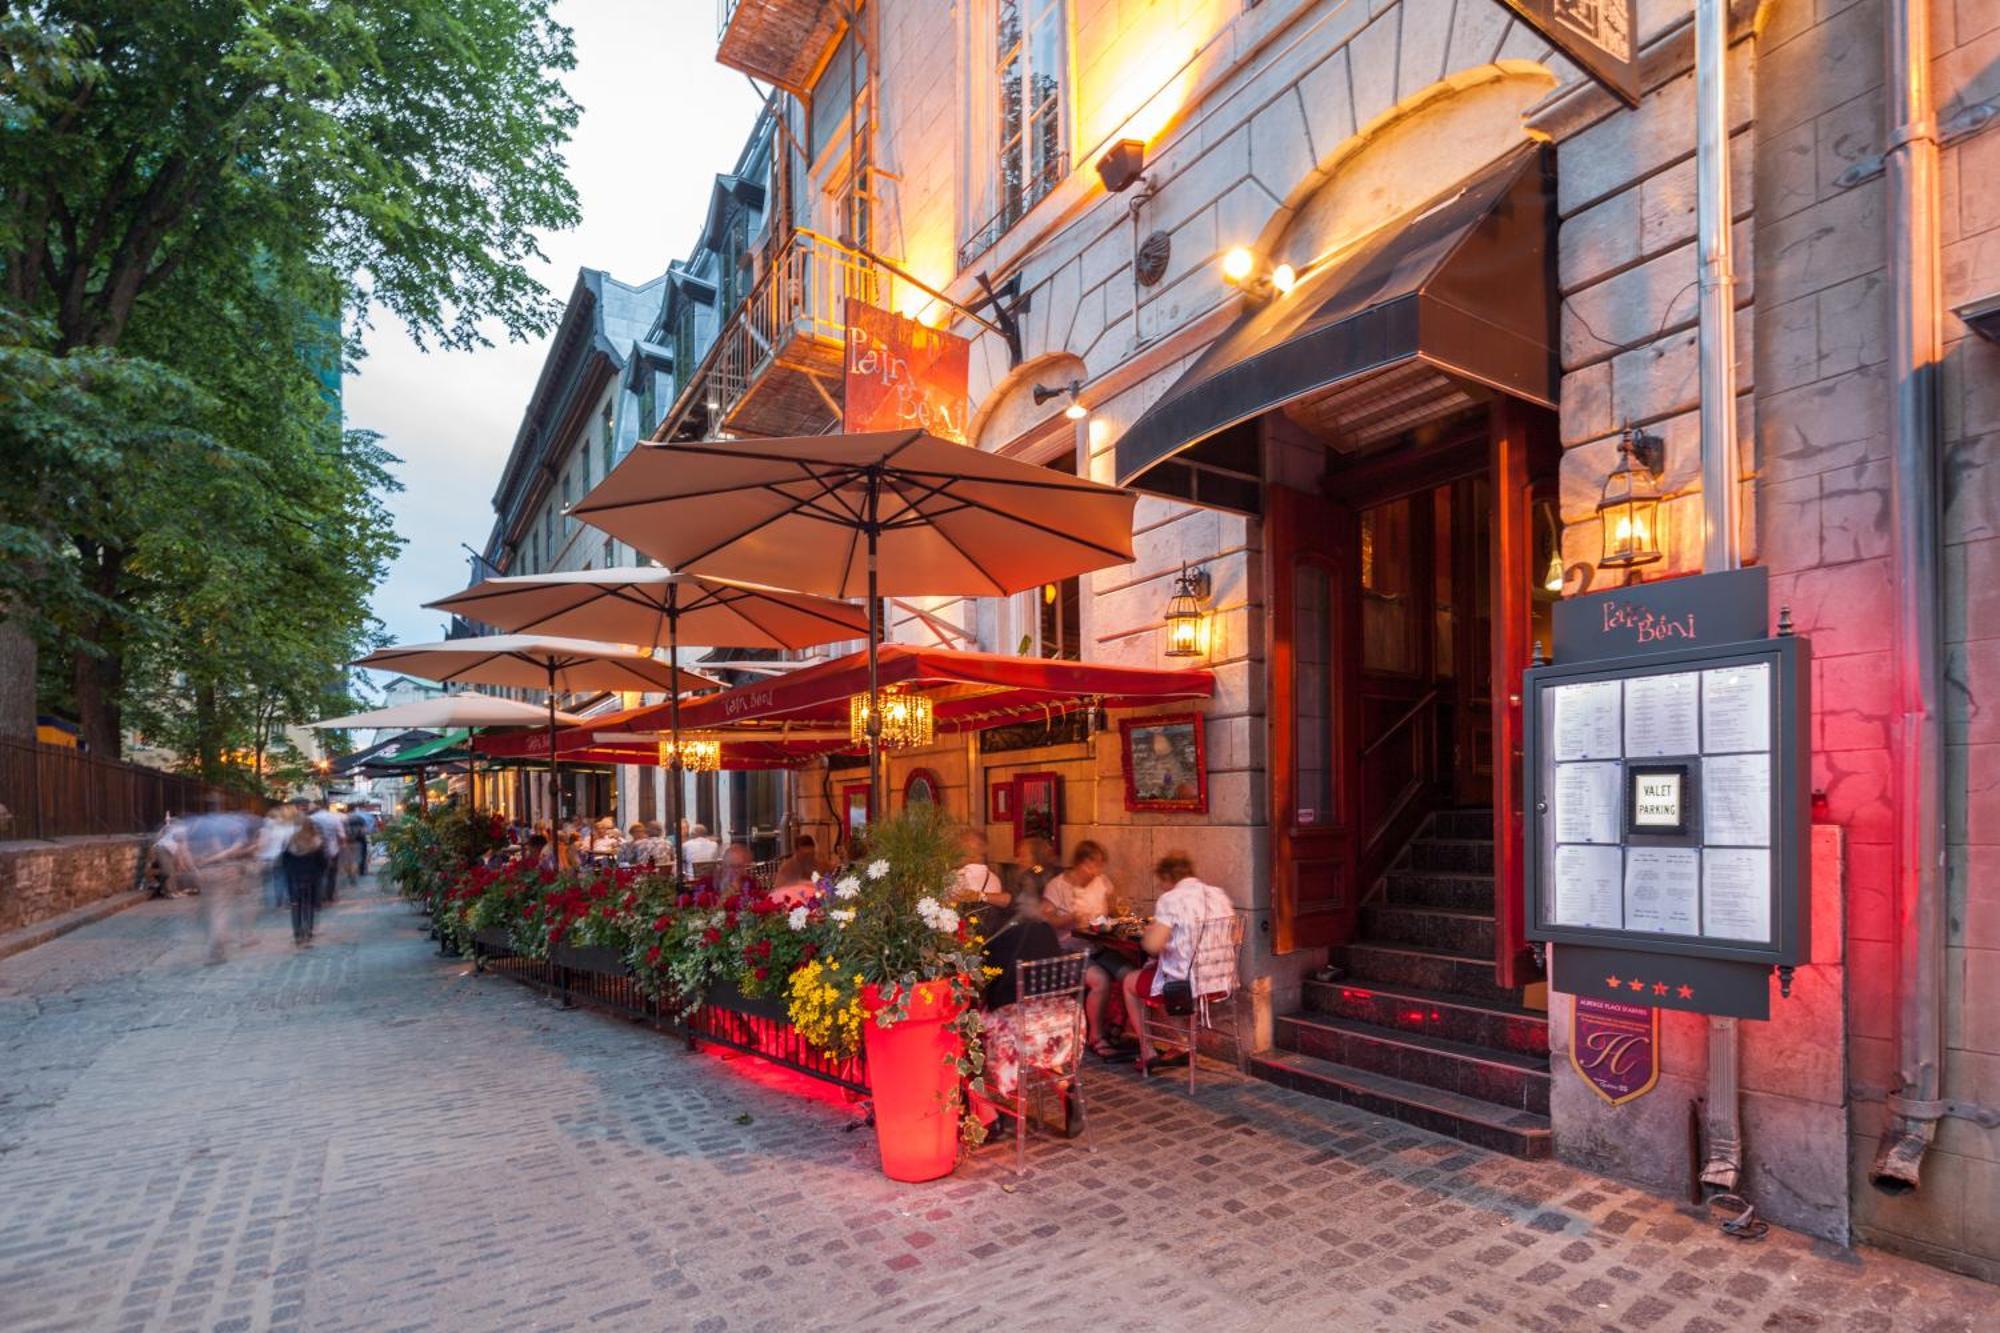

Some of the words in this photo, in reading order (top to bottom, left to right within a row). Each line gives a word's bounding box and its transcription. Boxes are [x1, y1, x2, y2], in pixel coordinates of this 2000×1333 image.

[849, 327, 917, 390] Pain
[1637, 613, 1697, 642] Béni
[1643, 784, 1671, 797] VALET
[1639, 804, 1676, 816] PARKING
